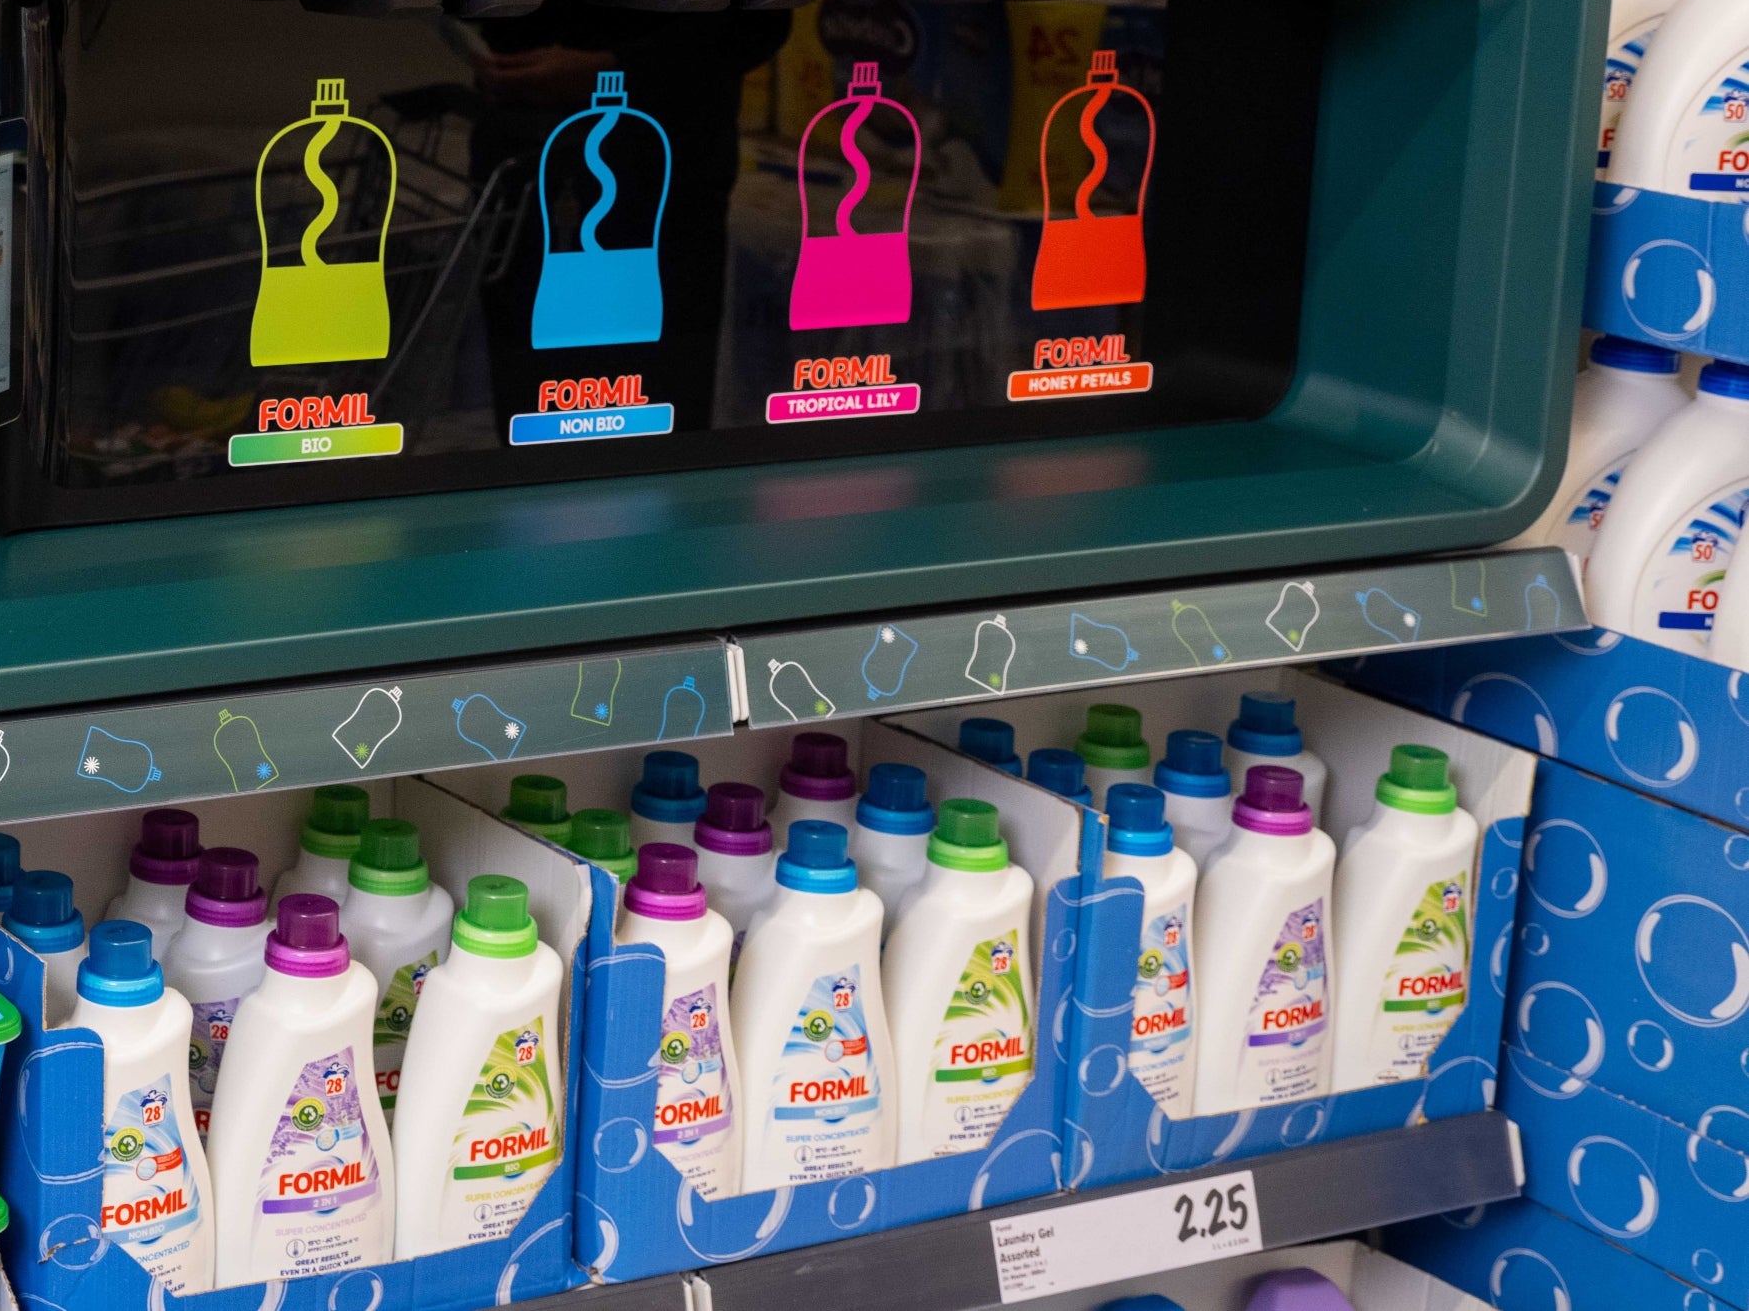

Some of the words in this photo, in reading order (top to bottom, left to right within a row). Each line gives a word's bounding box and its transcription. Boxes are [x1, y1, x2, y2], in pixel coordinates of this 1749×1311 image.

[1033, 334, 1130, 369] FORMIL
[793, 354, 897, 390] FORMIL
[1028, 375, 1078, 393] HONEY
[1080, 371, 1132, 389] PETALS
[538, 375, 649, 412] FORMIL
[787, 395, 862, 415] TROPICAL
[866, 392, 900, 410] LILY
[258, 393, 375, 431] FORMIL
[560, 417, 592, 435] NON
[595, 414, 625, 432] BIO
[301, 437, 332, 454] BIO
[1399, 971, 1464, 1000] FORMIL
[470, 1128, 550, 1162] FORMIL
[504, 1163, 520, 1173] BIO
[1174, 1183, 1248, 1242] 2.25
[997, 1231, 1035, 1248] Laundry
[1038, 1226, 1055, 1240] Gel
[1000, 1246, 1041, 1263] Assorted
